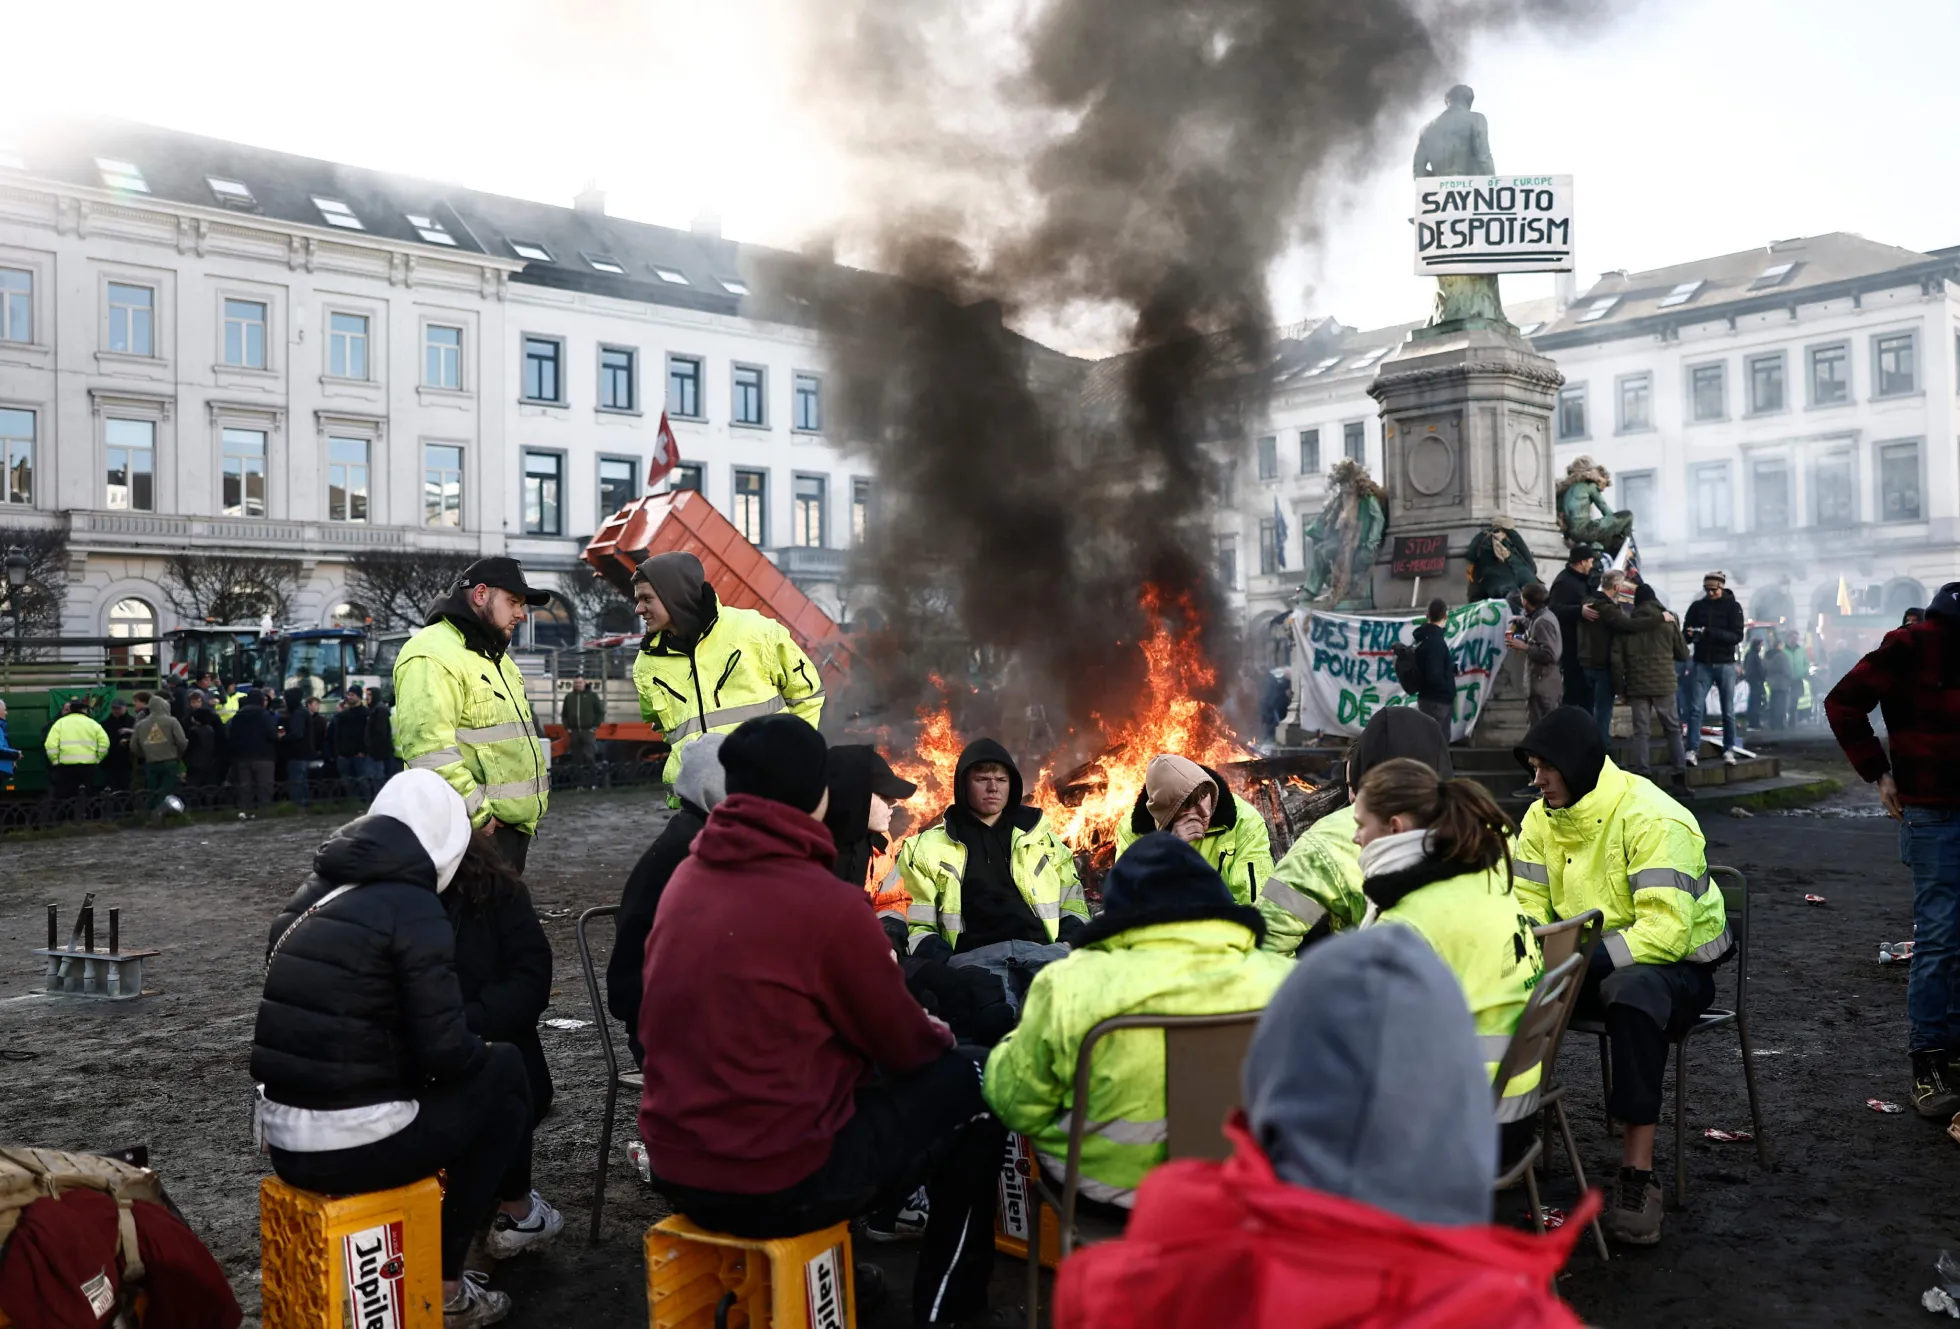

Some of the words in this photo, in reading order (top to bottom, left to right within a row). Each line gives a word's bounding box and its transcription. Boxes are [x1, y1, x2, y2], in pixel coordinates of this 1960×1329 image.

[1439, 180, 1473, 189] PEOPLE
[1488, 178, 1500, 187] OF
[1513, 177, 1553, 187] EUROPE
[1404, 536, 1442, 555] STOP
[1311, 616, 1349, 650] DES
[1359, 620, 1404, 651] PRIX
[1412, 601, 1506, 638] STES
[1313, 648, 1371, 685] POUR
[1377, 657, 1398, 682] DE
